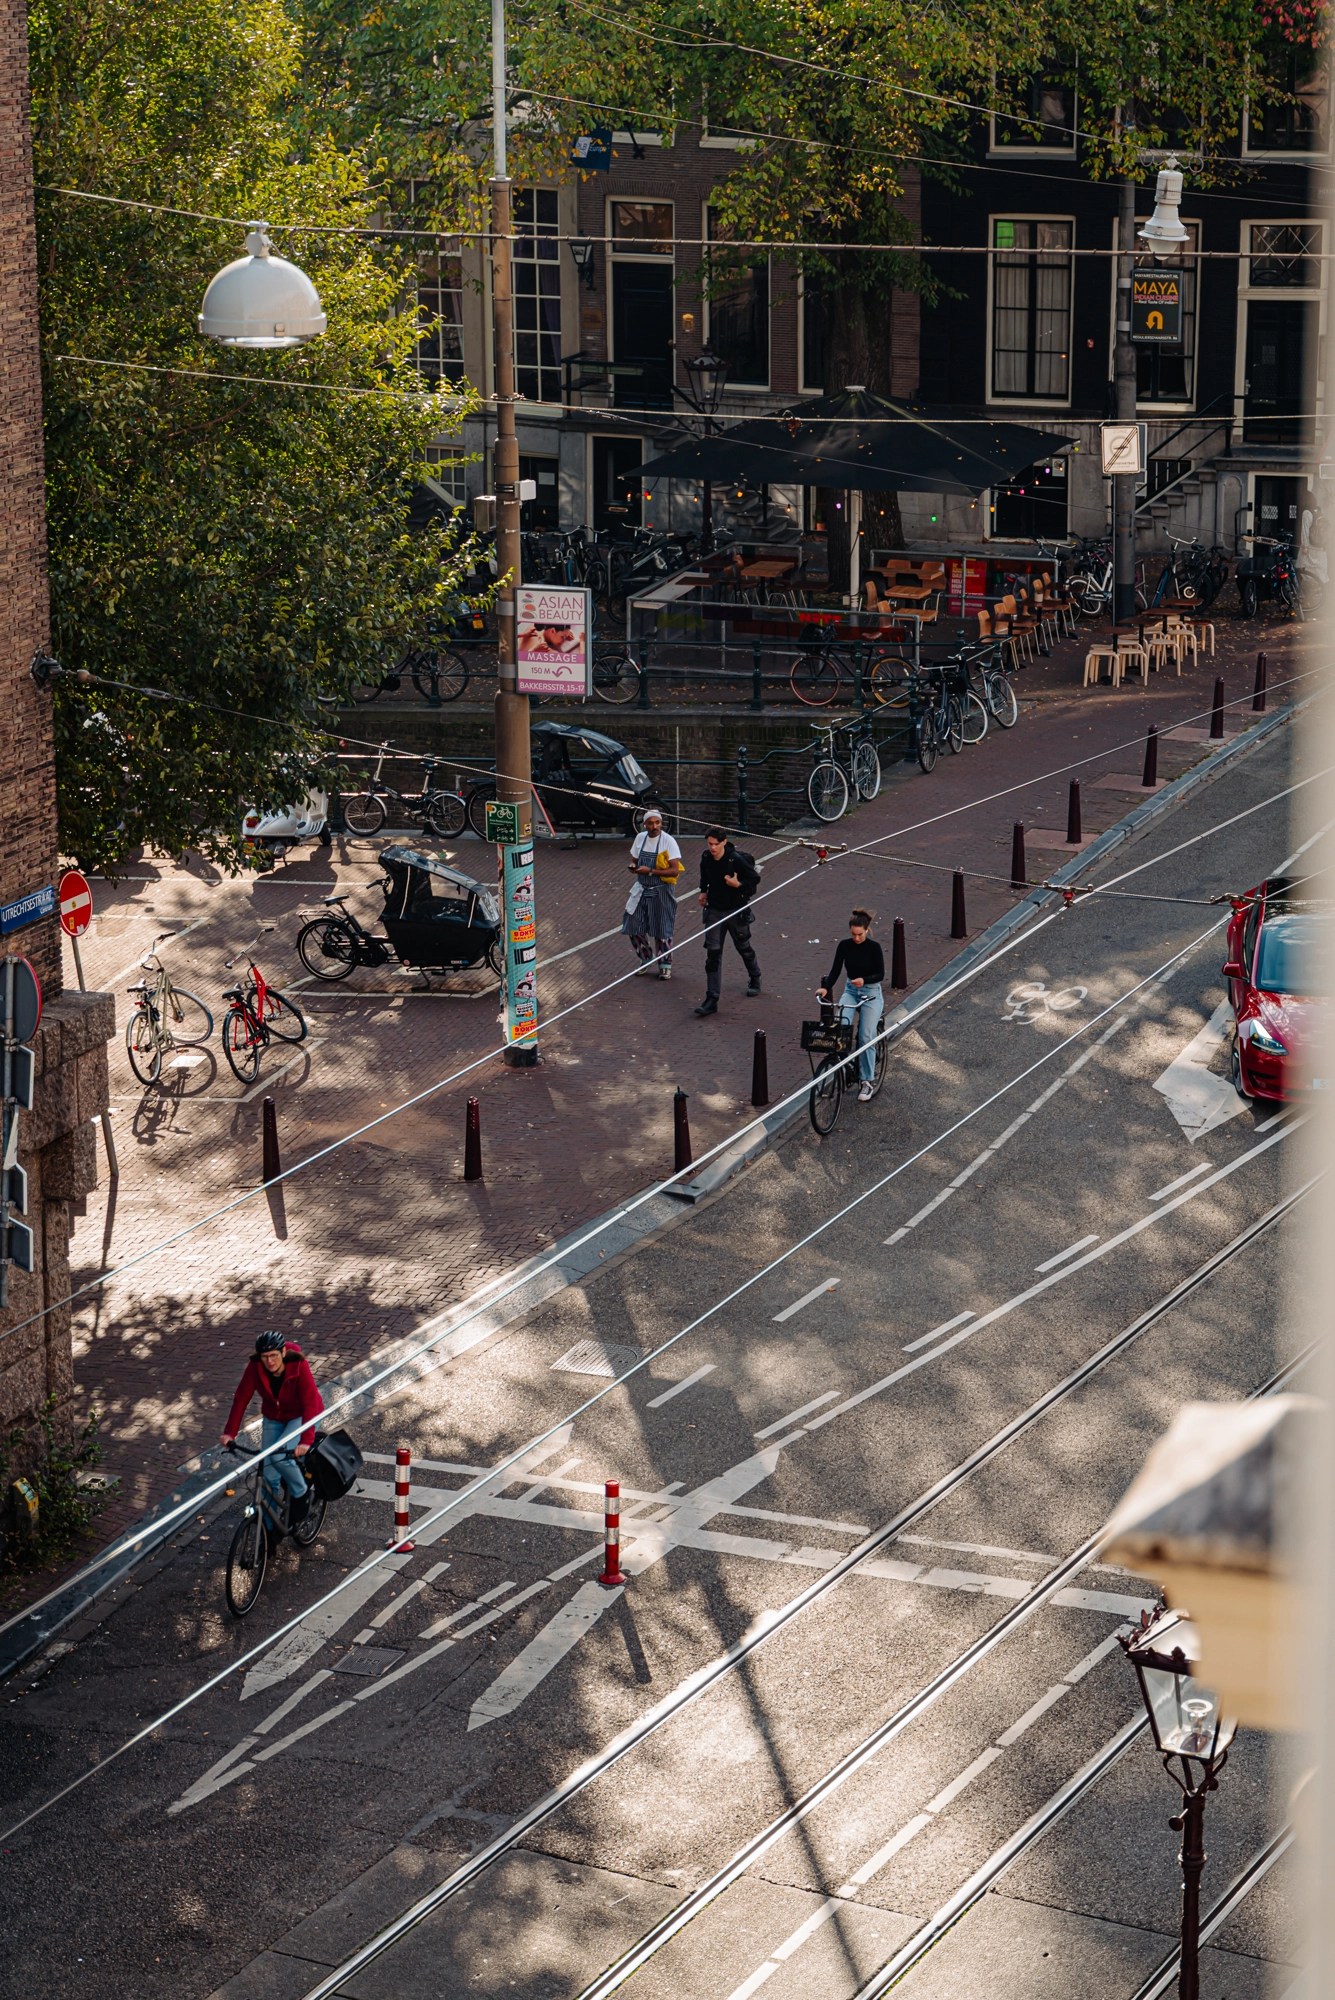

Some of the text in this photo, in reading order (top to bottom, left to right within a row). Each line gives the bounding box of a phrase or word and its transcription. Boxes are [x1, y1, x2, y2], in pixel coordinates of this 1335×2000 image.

[1133, 281, 1179, 295] MAYA
[538, 596, 583, 610] ASIAN
[538, 609, 583, 620] BEAUTY
[527, 652, 578, 663] MASSAGE
[531, 667, 542, 675] 150
[2, 889, 53, 923] UTRECHTSESTRAAT
